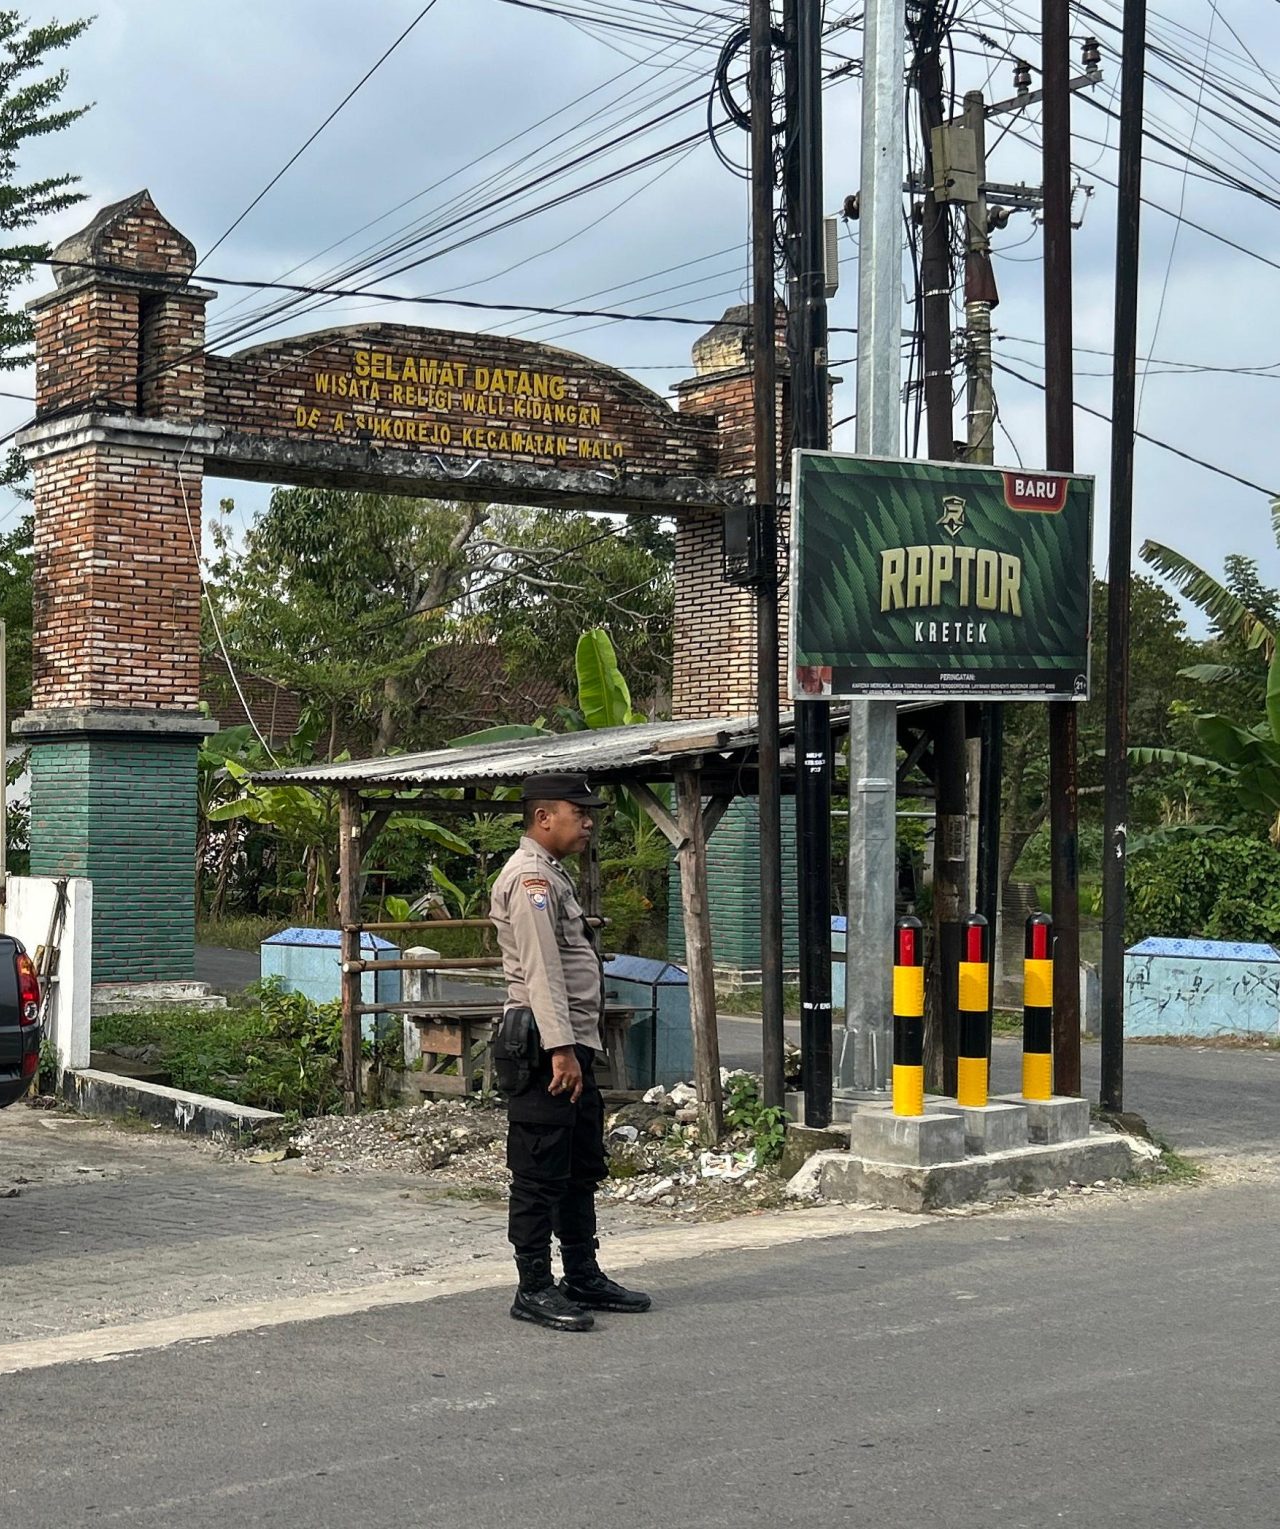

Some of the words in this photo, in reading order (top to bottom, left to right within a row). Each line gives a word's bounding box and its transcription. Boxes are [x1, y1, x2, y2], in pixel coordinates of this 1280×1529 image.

[354, 351, 469, 388] SELAMAT
[475, 366, 564, 400] DATANG
[315, 373, 380, 401] WISATA
[393, 384, 452, 410] RELIGI
[462, 392, 503, 415] WALI
[514, 397, 601, 425] KIDANGAN
[462, 427, 568, 456] KECAMATAN
[578, 438, 623, 460] MALO
[1015, 479, 1057, 499] BARU
[880, 545, 1022, 617] RAPTOR
[914, 622, 988, 643] KRETEK
[940, 673, 975, 681] PERINGATAN:
